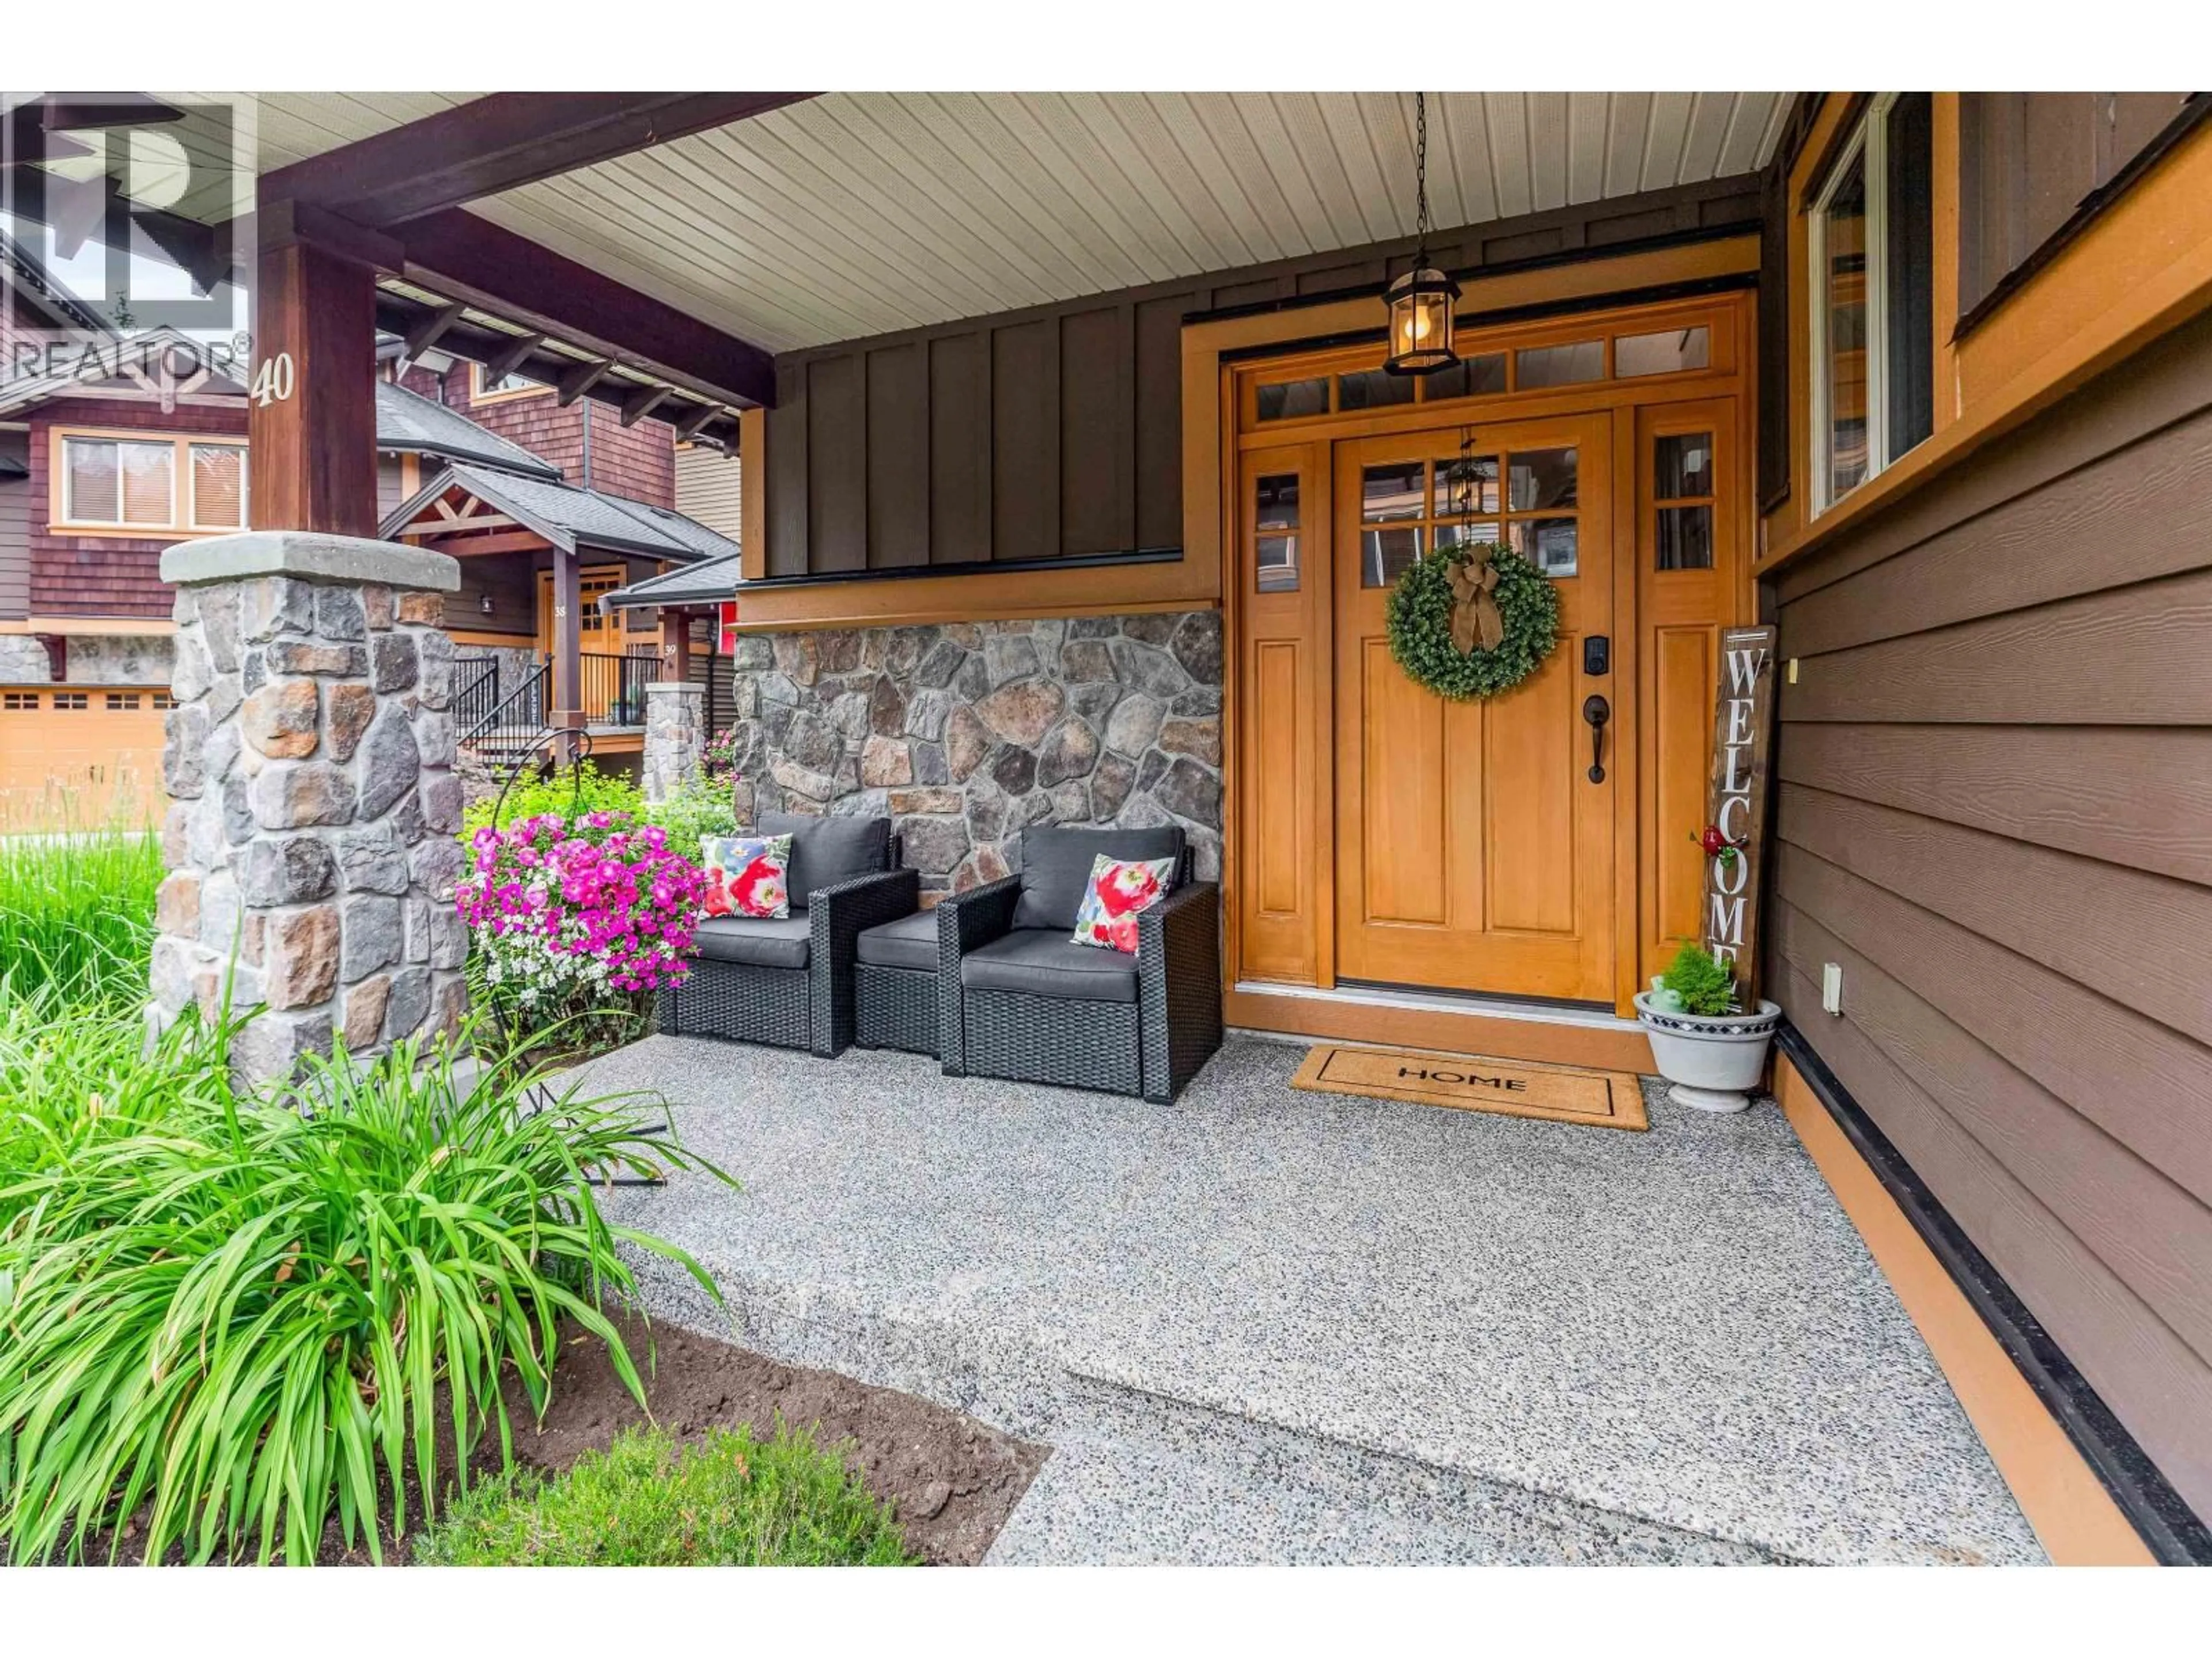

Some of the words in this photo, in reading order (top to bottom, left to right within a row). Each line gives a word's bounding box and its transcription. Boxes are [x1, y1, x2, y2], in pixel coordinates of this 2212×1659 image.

[251, 352, 294, 407] 40
[665, 645, 676, 656] 39
[1398, 1067, 1527, 1092] HOME
